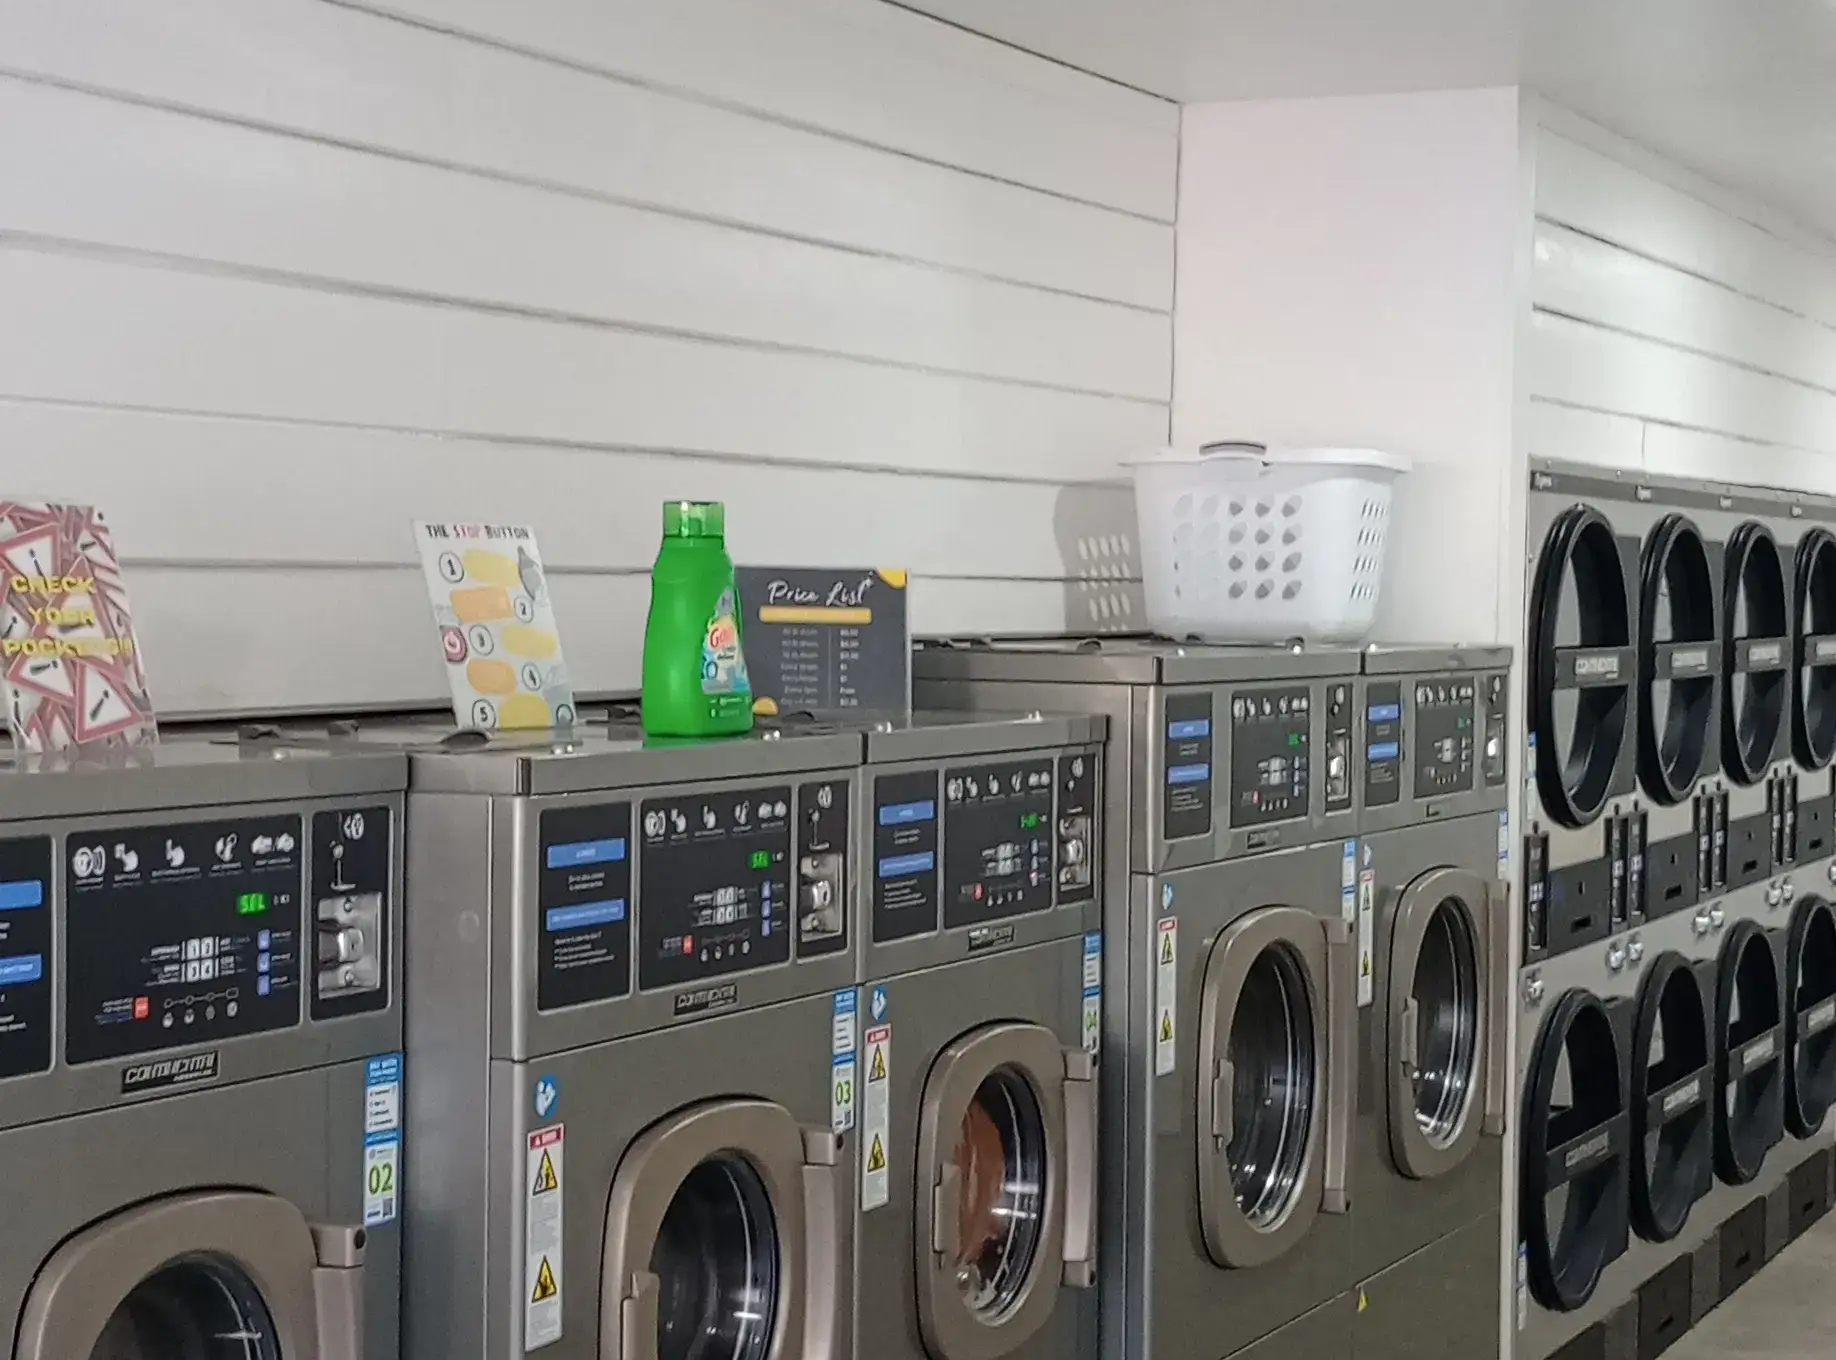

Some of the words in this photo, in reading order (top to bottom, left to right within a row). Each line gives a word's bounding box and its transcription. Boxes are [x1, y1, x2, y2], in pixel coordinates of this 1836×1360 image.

[11, 575, 96, 594] CHECK
[768, 580, 819, 605] Price
[835, 1080, 851, 1106] 03
[368, 1162, 393, 1194] 02
